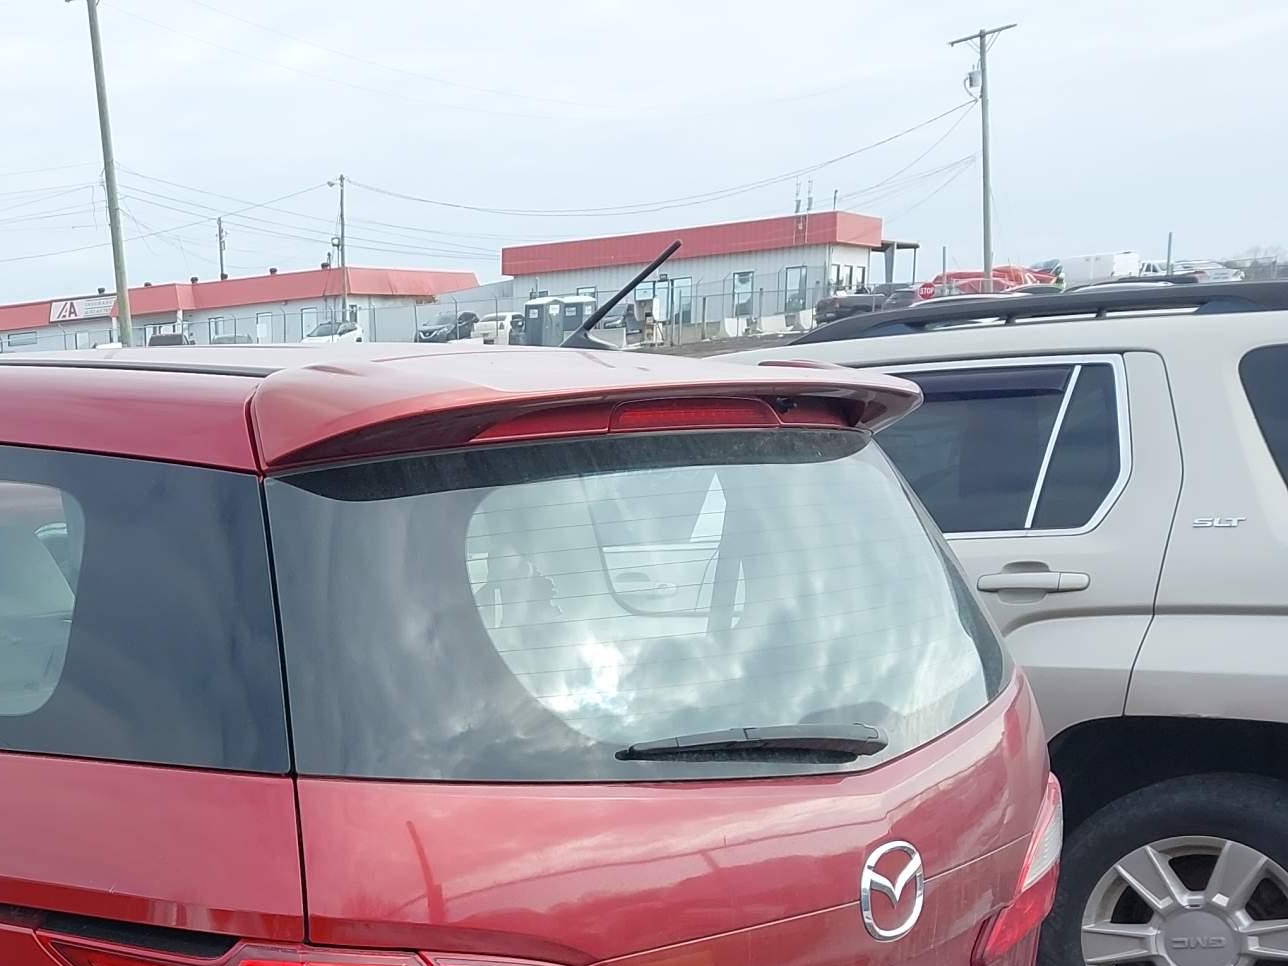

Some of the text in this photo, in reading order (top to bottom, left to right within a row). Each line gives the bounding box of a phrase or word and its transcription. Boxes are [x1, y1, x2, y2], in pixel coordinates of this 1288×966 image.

[919, 287, 935, 295] STOP
[1192, 516, 1246, 528] SLT
[1170, 936, 1226, 950] GMC
